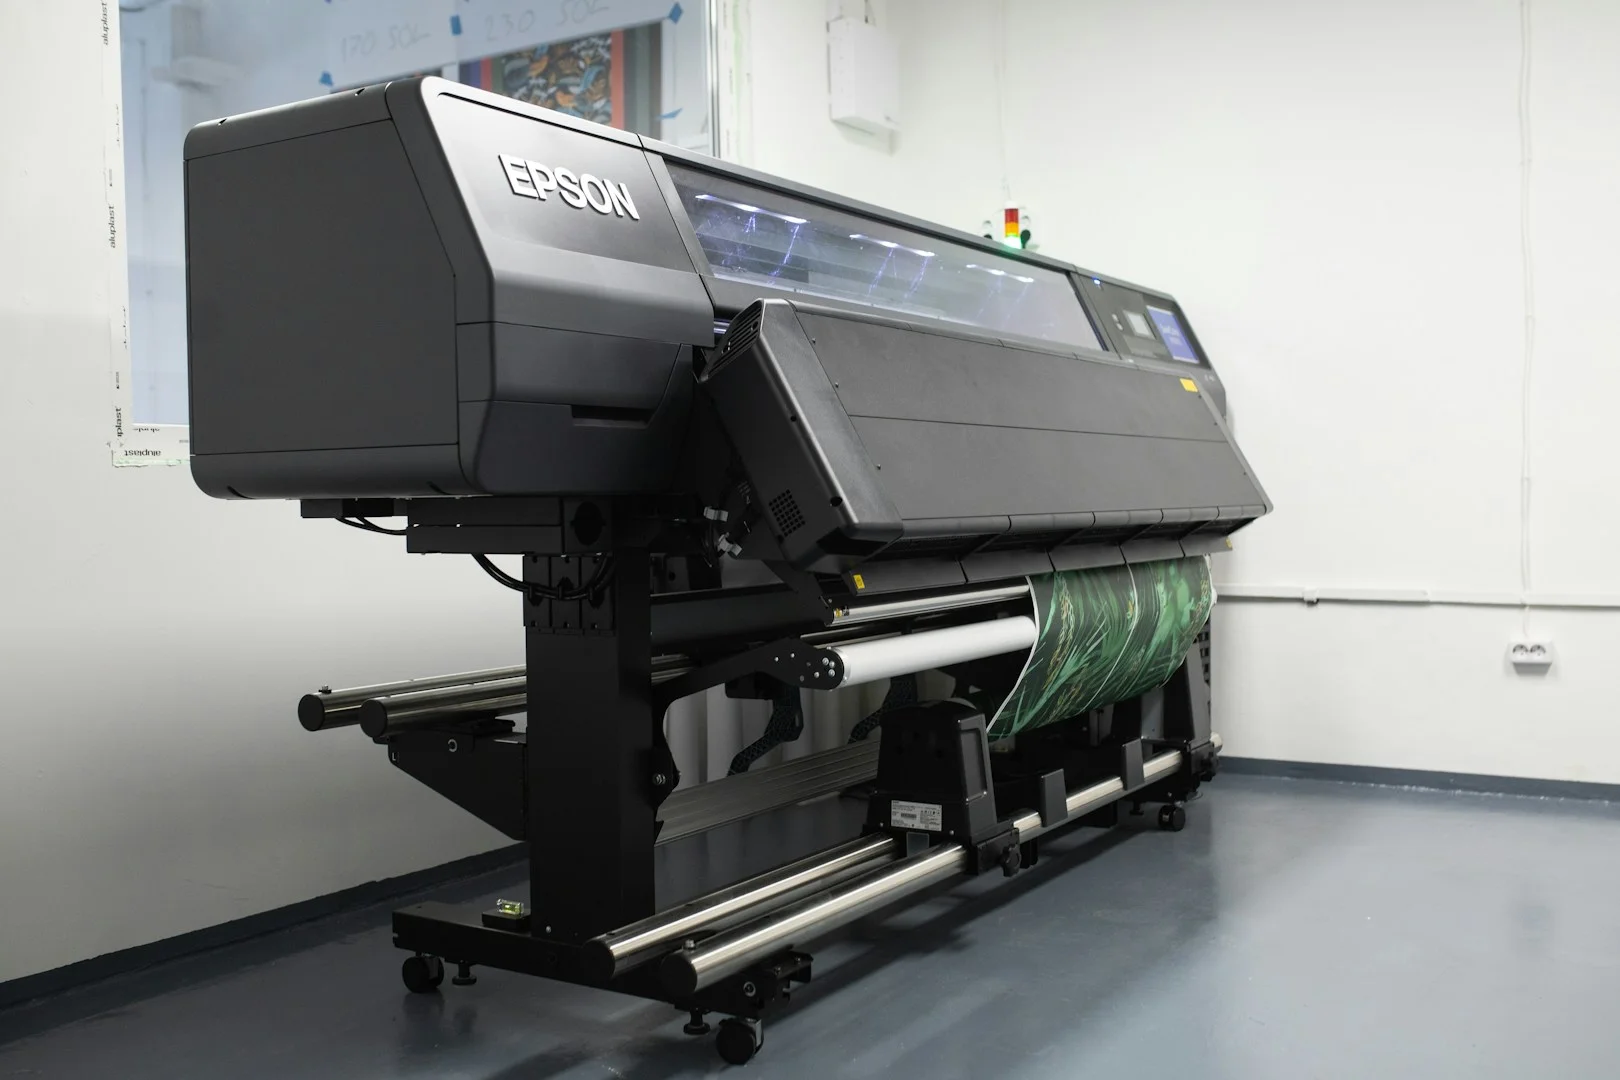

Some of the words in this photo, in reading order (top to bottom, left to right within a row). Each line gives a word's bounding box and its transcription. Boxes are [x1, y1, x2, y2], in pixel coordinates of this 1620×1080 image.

[498, 153, 640, 221] EPSON
[108, 204, 116, 249] aluplast
[124, 449, 161, 457] aluplast
